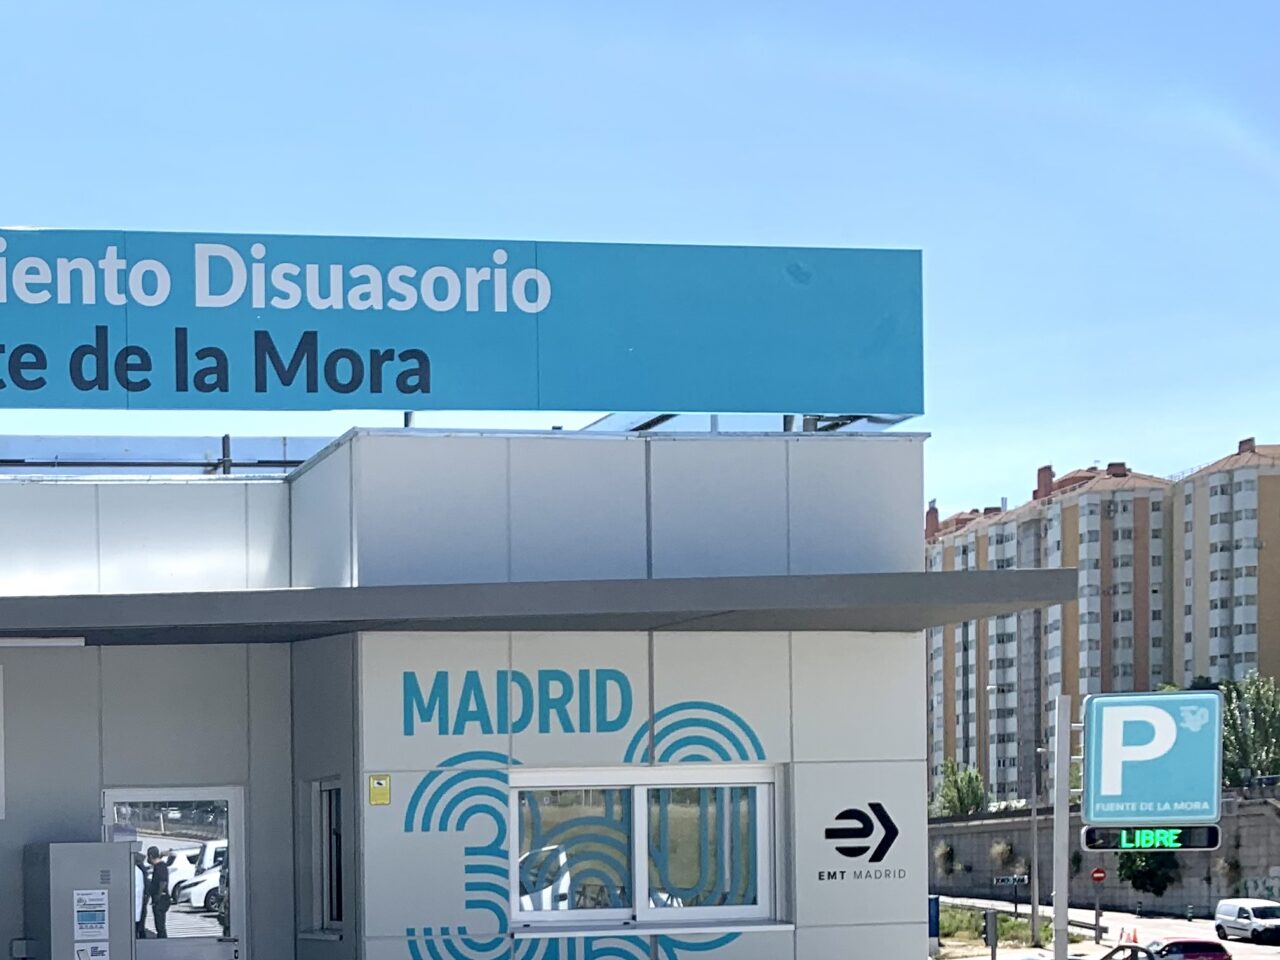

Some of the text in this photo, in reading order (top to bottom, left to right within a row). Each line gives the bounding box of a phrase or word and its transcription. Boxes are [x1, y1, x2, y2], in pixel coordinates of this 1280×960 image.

[193, 243, 552, 314] Disuasorio
[69, 325, 152, 391] de
[175, 327, 229, 393] la
[254, 330, 431, 393] Mora
[402, 669, 633, 736] MADRID
[1100, 705, 1177, 796] P
[1095, 801, 1210, 812] FUENTE DE LA MORA
[1120, 829, 1183, 849] LIBRE
[818, 868, 907, 881] EMT MADRID
